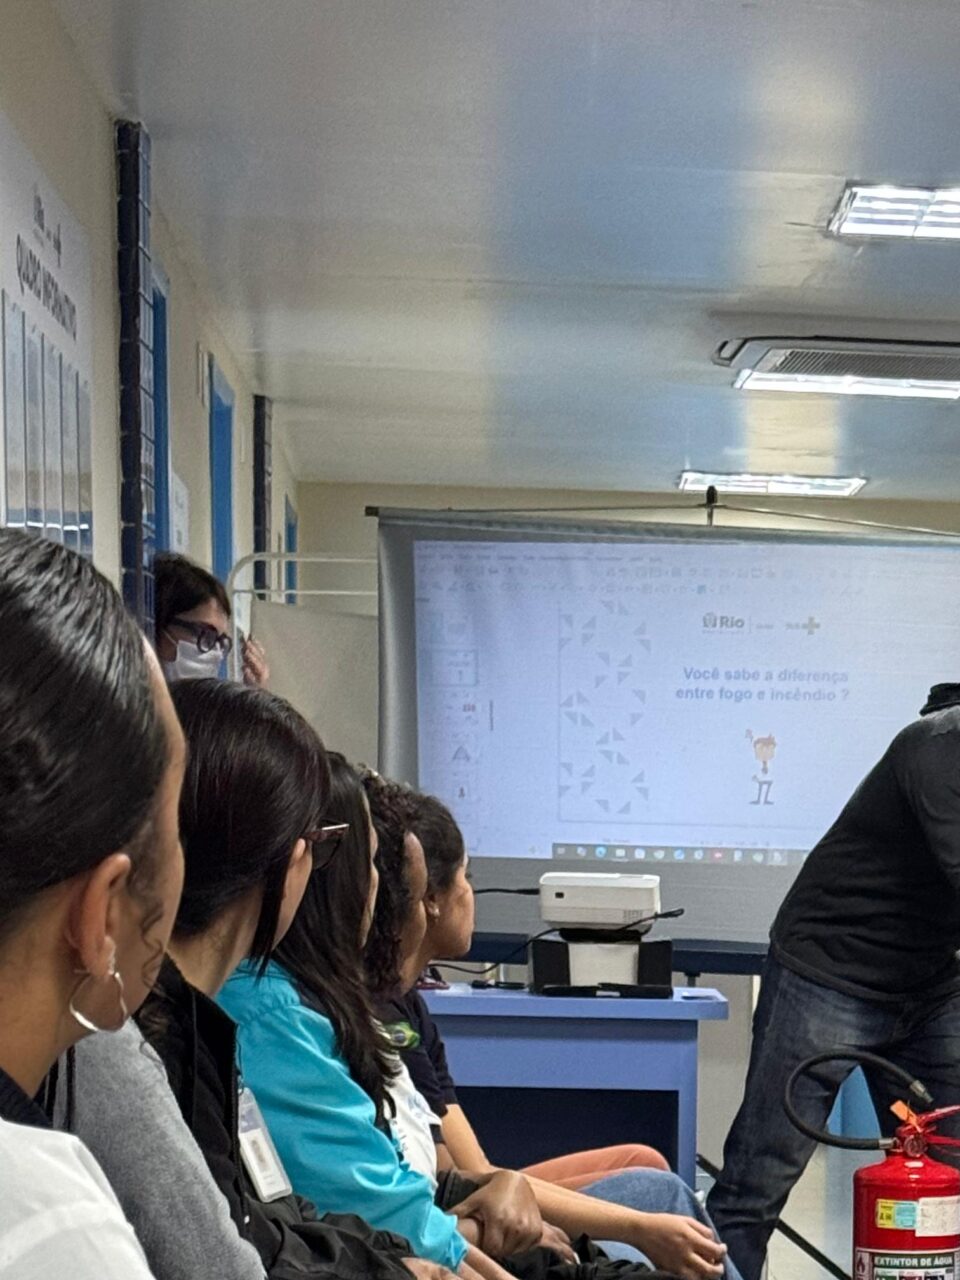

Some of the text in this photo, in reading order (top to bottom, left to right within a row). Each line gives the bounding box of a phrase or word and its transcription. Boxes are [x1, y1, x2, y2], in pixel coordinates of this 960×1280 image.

[720, 615, 745, 629] Rio
[683, 667, 849, 684] Você sabe a diferença
[675, 686, 849, 703] entre fogo e incêndio ?
[874, 1256, 953, 1266] EXTINTOR DE ÁGUA
